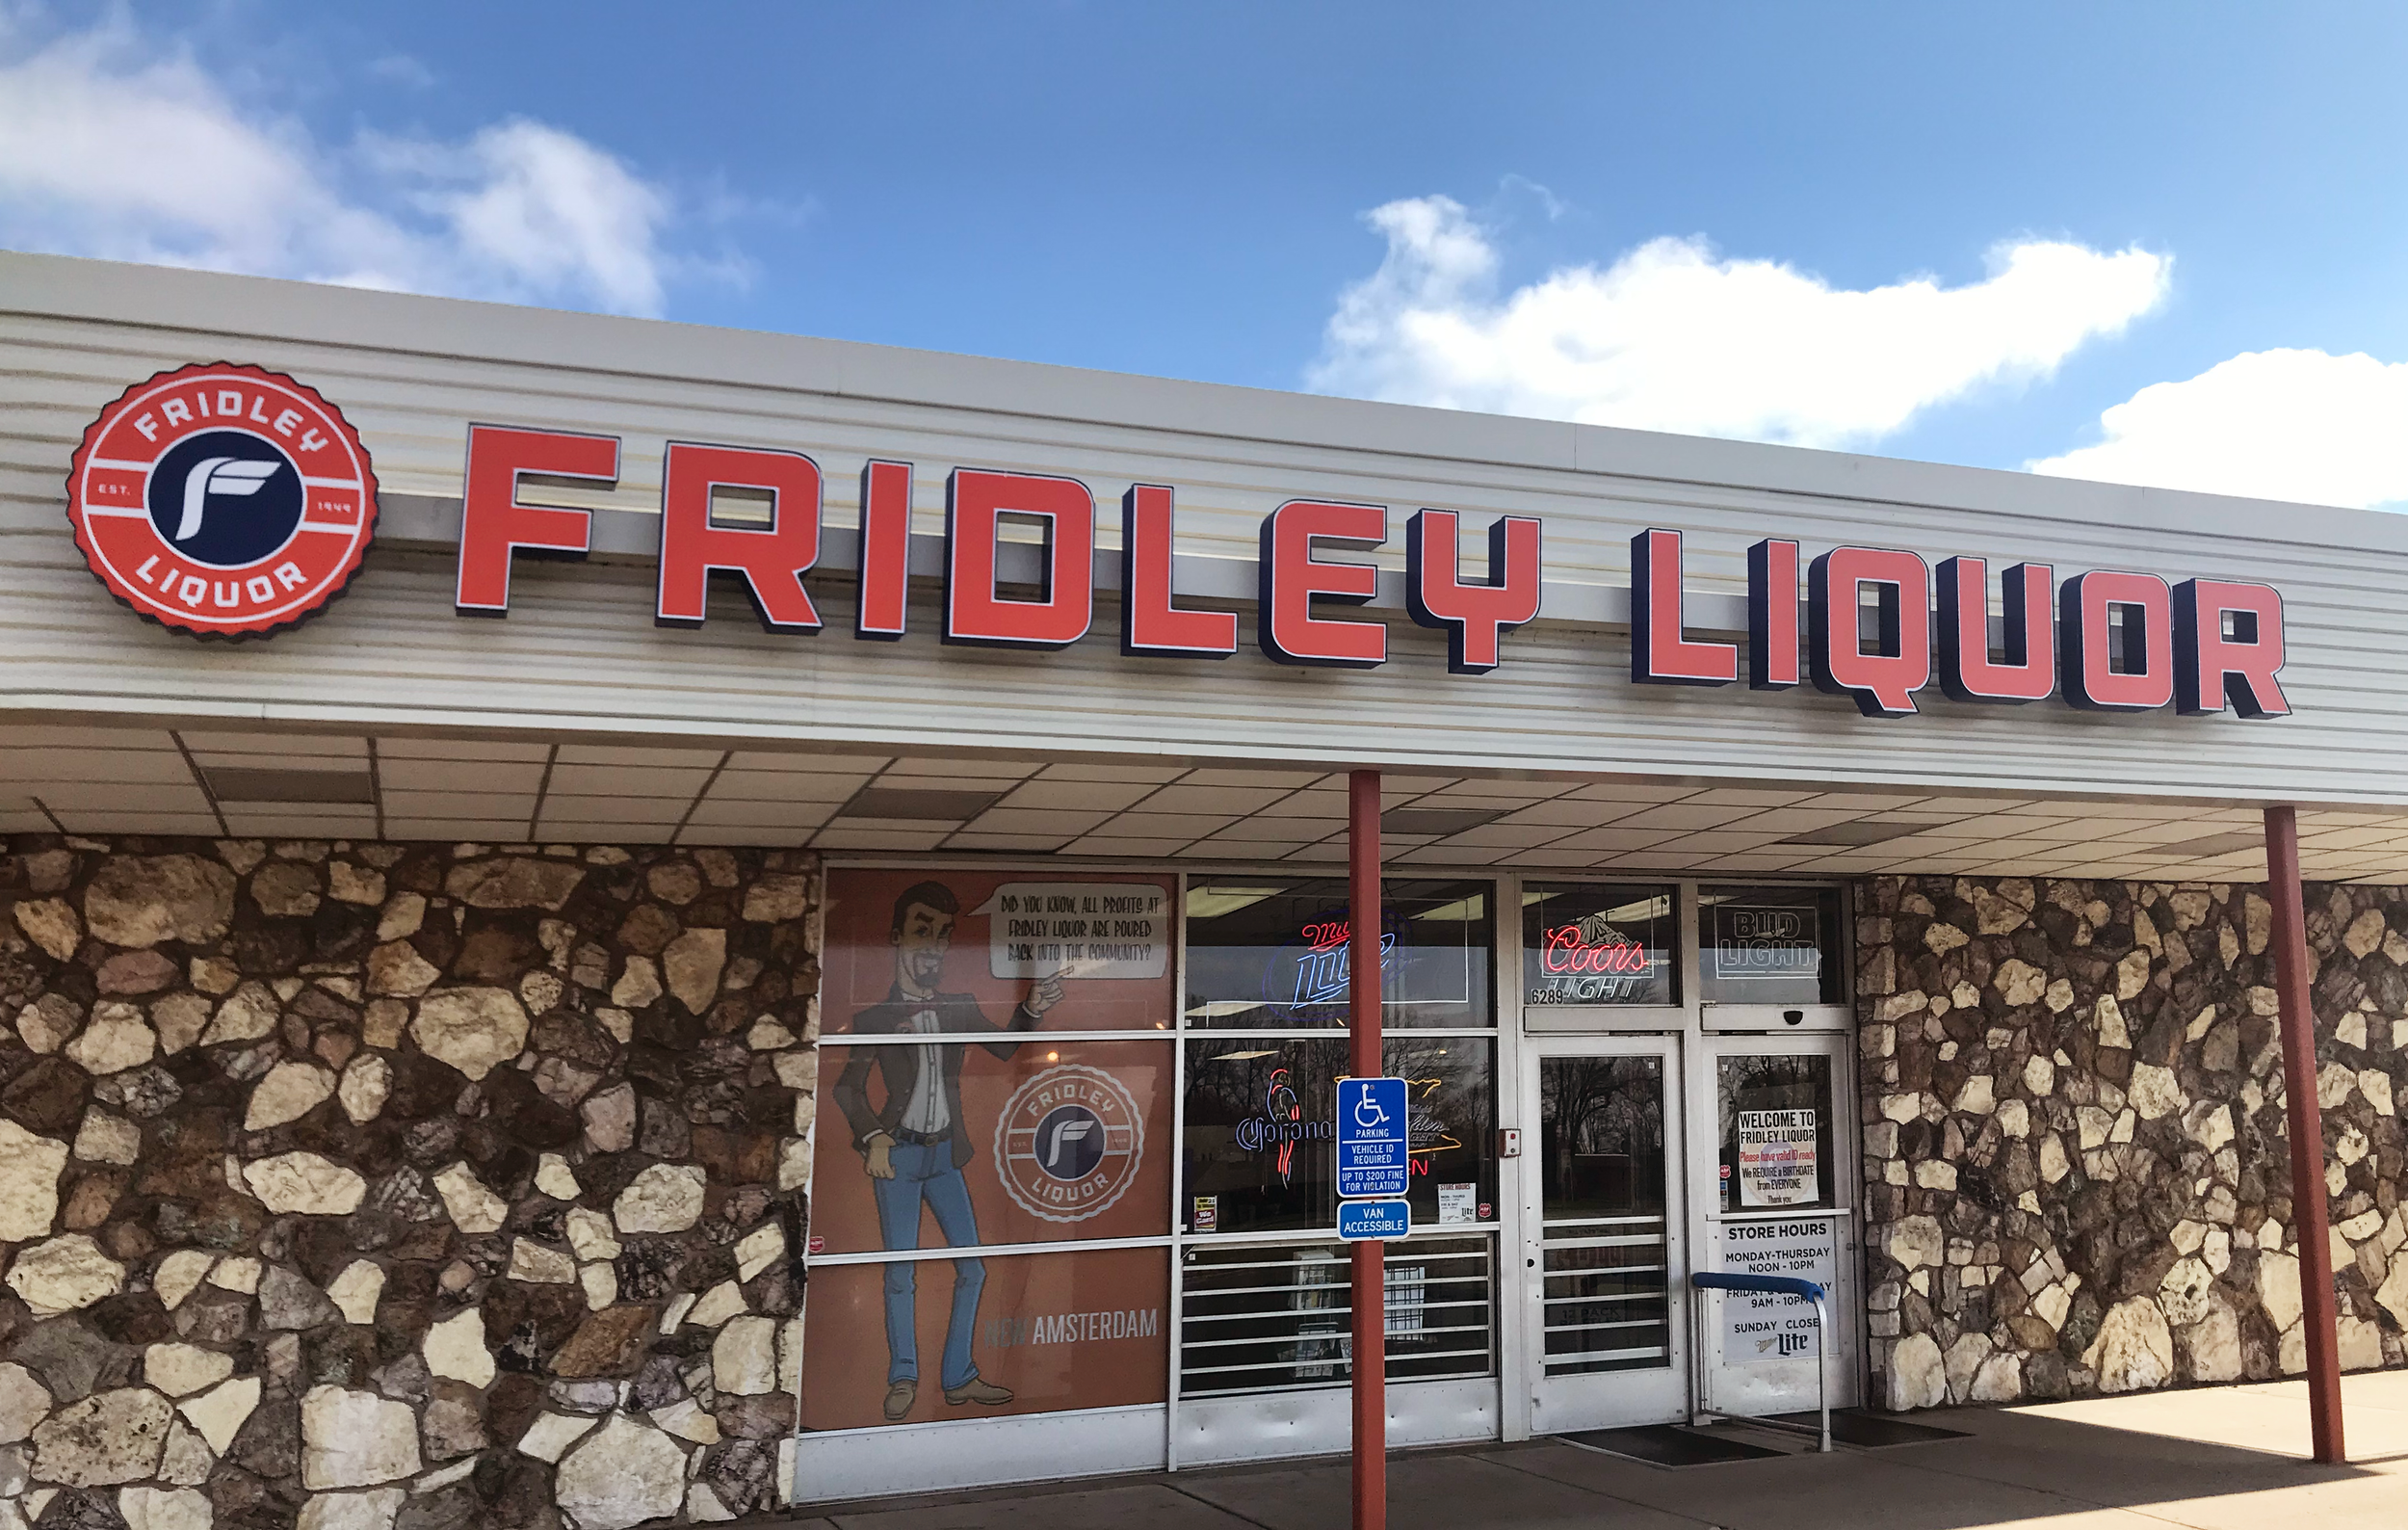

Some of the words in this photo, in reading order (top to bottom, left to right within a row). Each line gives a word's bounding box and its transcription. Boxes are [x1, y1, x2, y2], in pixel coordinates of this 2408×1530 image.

[133, 390, 328, 453] FRIDLEY
[98, 483, 131, 496] EST.
[456, 422, 1541, 673] FRIDLEY
[1631, 527, 2292, 719] LIQUOR
[136, 555, 307, 608] LIQUOR
[1002, 895, 1018, 913] DID
[1023, 895, 1042, 913] YOU
[1047, 896, 1077, 915] KNOW,
[1082, 896, 1098, 913] ALL
[1103, 896, 1143, 913] PROFITS
[1147, 897, 1160, 914] AT
[1008, 919, 1049, 937] FRIDLEY
[1053, 919, 1086, 938] LIQUOR
[1091, 919, 1110, 937] ARE
[1114, 920, 1152, 937] POURED
[1734, 911, 1801, 938] BUD
[1008, 943, 1034, 962] BACK
[1037, 943, 1060, 962] INTO
[1065, 943, 1084, 962] THE
[1088, 943, 1151, 962] COMMUNITY?
[1541, 925, 1649, 973] Coors
[1719, 938, 1814, 966] LIGHT
[1531, 989, 1563, 1004] 6289
[1027, 1084, 1116, 1117] FRIDLEY
[1408, 1114, 1450, 1132] lden
[1740, 1112, 1796, 1128] WELCOME
[1799, 1111, 1815, 1126] TO
[1236, 1117, 1331, 1152] Corona
[1355, 1128, 1389, 1138] PARKING
[1741, 1130, 1779, 1144] FRIDLEY
[1782, 1129, 1815, 1143] LIQUOR
[1351, 1145, 1383, 1154] VEHICLE
[1386, 1144, 1395, 1153] ID
[1740, 1150, 1759, 1162] Please
[1761, 1150, 1774, 1161] have
[1775, 1149, 1791, 1161] valid
[1798, 1148, 1815, 1162] ready
[1353, 1154, 1392, 1165] REQUIRED
[1342, 1173, 1352, 1181] UP
[1354, 1172, 1363, 1181] TO
[1366, 1171, 1385, 1181] $200
[1387, 1170, 1404, 1179] FINE
[1741, 1168, 1752, 1178] We
[1752, 1167, 1777, 1178] REQUIRE
[1783, 1165, 1814, 1176] BIRTHDATE
[1032, 1172, 1109, 1203] LIQUOR
[1346, 1182, 1360, 1192] FOR
[1363, 1181, 1400, 1191] VIOLATION
[1757, 1180, 1770, 1190] from
[1770, 1178, 1801, 1190] EVERYONE
[1767, 1195, 1782, 1203] Thank
[1363, 1207, 1384, 1219] VAN
[1344, 1220, 1404, 1232] ACCESSIBLE
[1728, 1226, 1775, 1240] STORE
[1779, 1223, 1826, 1237] HOURS
[1725, 1247, 1830, 1262] MONDAY-THURSDAY
[1748, 1262, 1780, 1273] NOON
[1789, 1260, 1815, 1270] 10PM
[1751, 1298, 1773, 1308] 9AM
[1783, 1296, 1809, 1306] 10PM
[983, 1318, 1028, 1348] NEW
[1033, 1308, 1158, 1345] AMSTERDAM
[1734, 1321, 1777, 1333] SUNDAY
[1786, 1318, 1820, 1330] CLOSE
[1777, 1333, 1809, 1356] Lite
